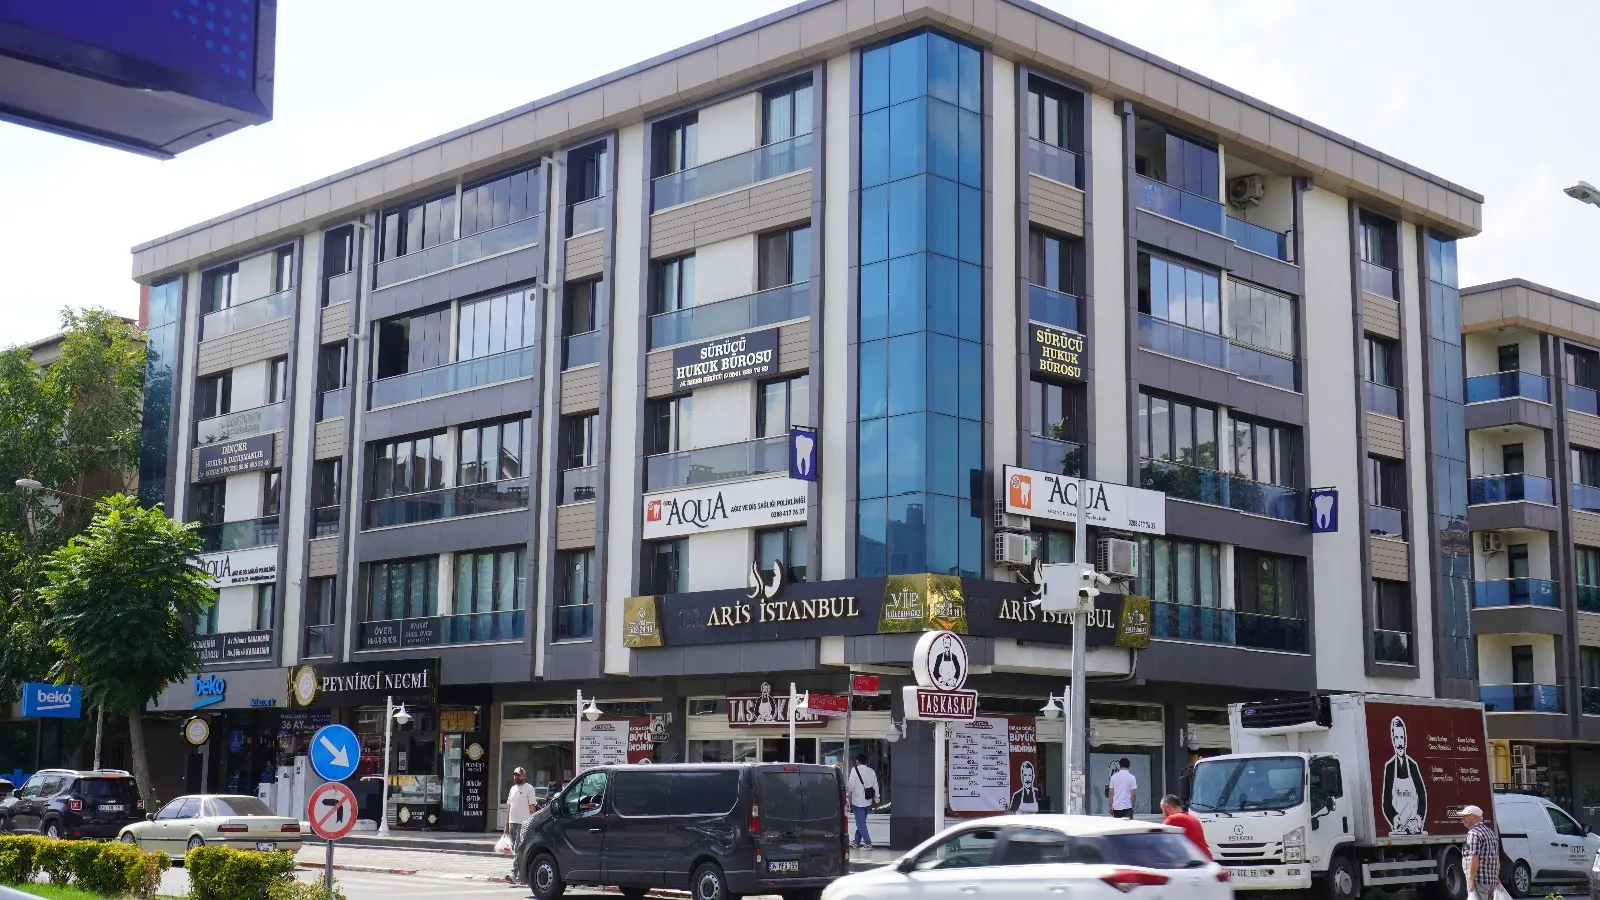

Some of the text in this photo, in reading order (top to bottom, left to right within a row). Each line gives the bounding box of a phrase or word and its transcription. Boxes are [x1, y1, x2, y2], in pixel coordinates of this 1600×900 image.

[700, 336, 747, 360] SÜRÜCÜ
[1036, 329, 1083, 352] SÜRÜCÜ
[676, 349, 773, 380] HUKUK BÜROSU
[1042, 346, 1078, 364] HUKUK
[1040, 358, 1081, 378] BÜROSU
[666, 491, 728, 528] AQUA
[707, 600, 750, 626] ARİS
[759, 596, 859, 623] İSTANBUL
[374, 625, 393, 635] ÖVER
[194, 672, 225, 695] beko
[322, 669, 429, 692] PEYNİRCİ NECMİ
[37, 689, 72, 704] beko
[920, 694, 973, 716] TAŞKASAP
[281, 720, 291, 729] 36
[293, 720, 304, 729] AY
[1009, 730, 1036, 742] BÜYÜK
[1009, 742, 1036, 754] İNDİRİM
